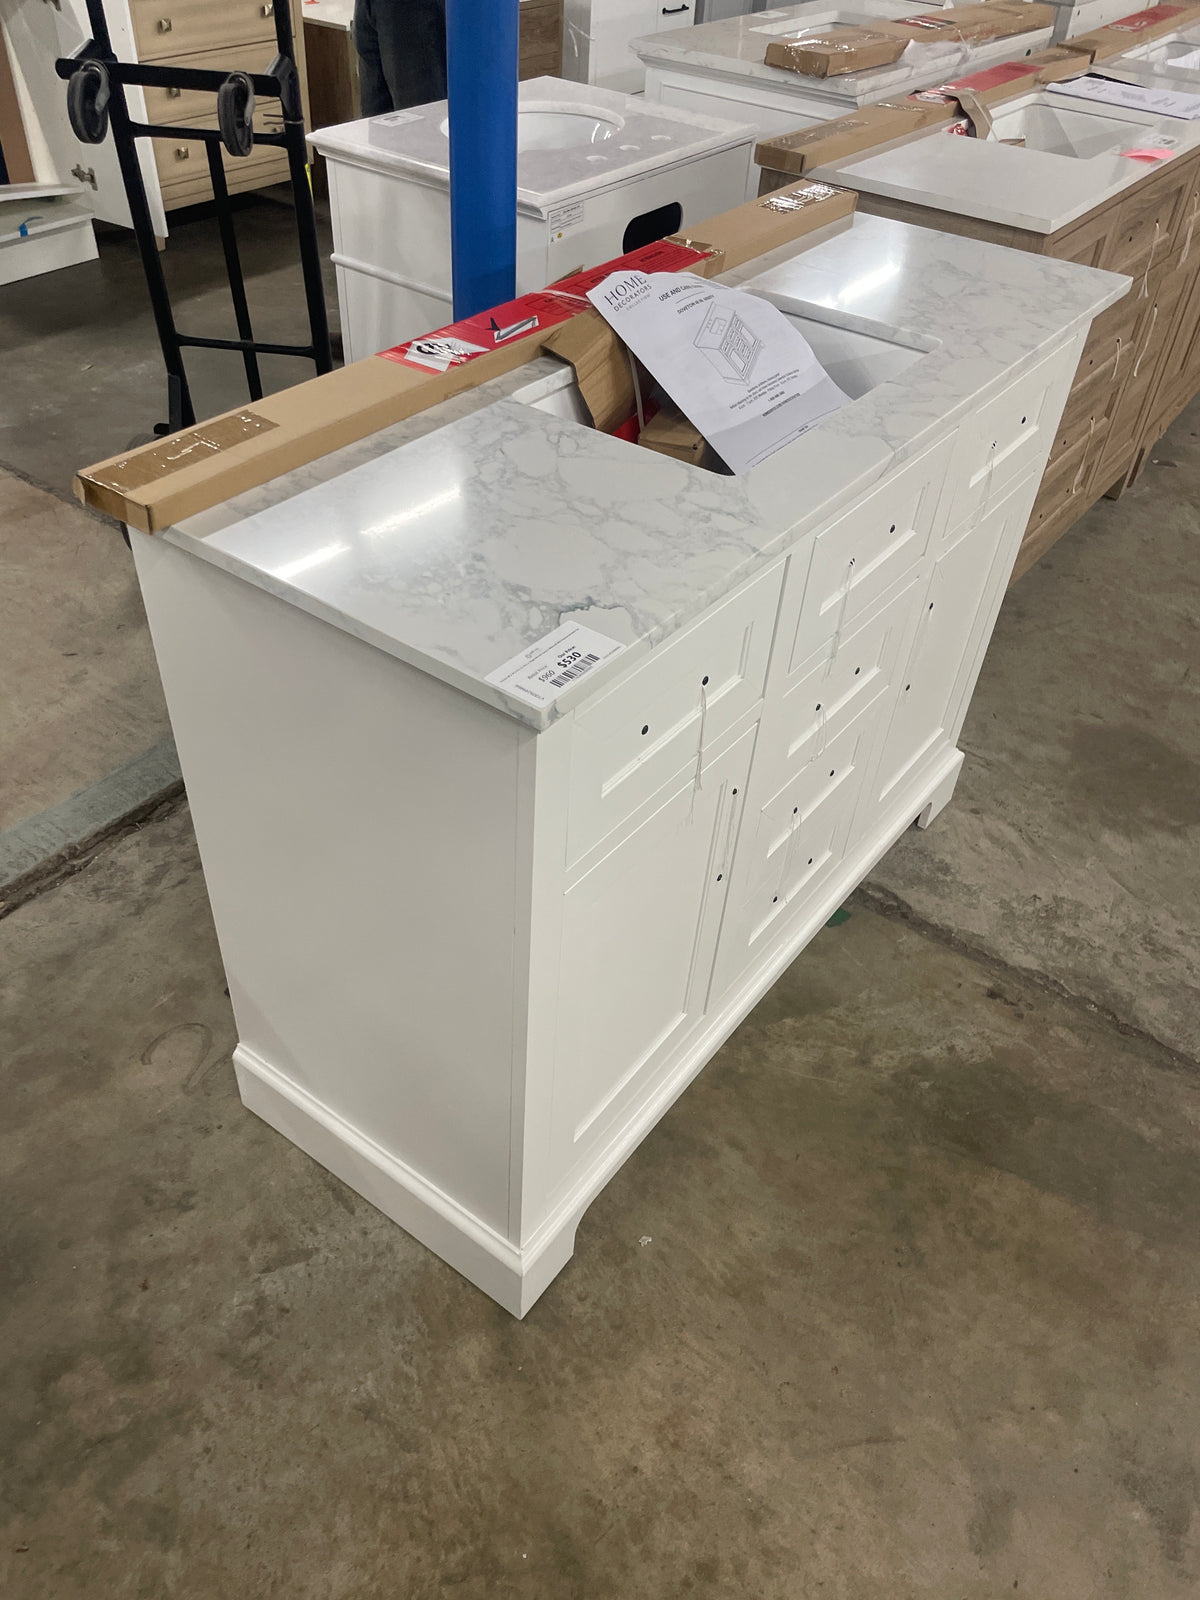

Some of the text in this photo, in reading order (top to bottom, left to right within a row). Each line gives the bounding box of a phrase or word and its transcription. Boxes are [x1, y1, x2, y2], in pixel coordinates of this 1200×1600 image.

[604, 275, 647, 306] HOME
[613, 284, 652, 312] DECORATORS
[658, 293, 671, 302] USE
[670, 287, 682, 296] AND
[557, 651, 582, 669] $530
[538, 669, 556, 683] $960
